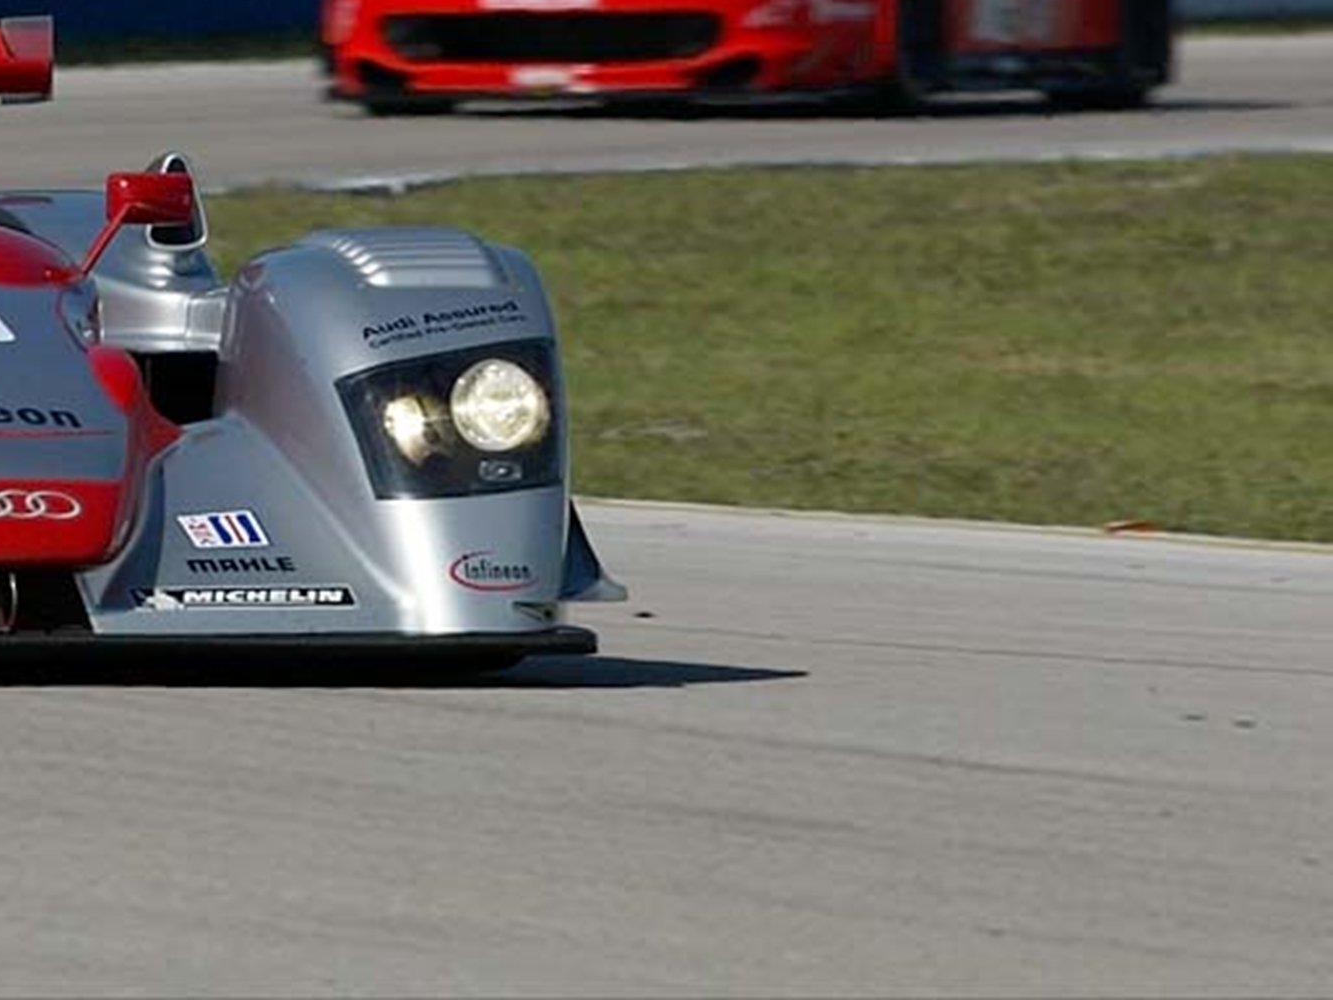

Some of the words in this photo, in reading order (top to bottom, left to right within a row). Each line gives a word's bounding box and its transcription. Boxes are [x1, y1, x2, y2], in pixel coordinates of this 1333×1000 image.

[363, 315, 416, 340] Audi
[186, 556, 295, 573] MAHLE
[183, 589, 344, 604] MICHELIN
